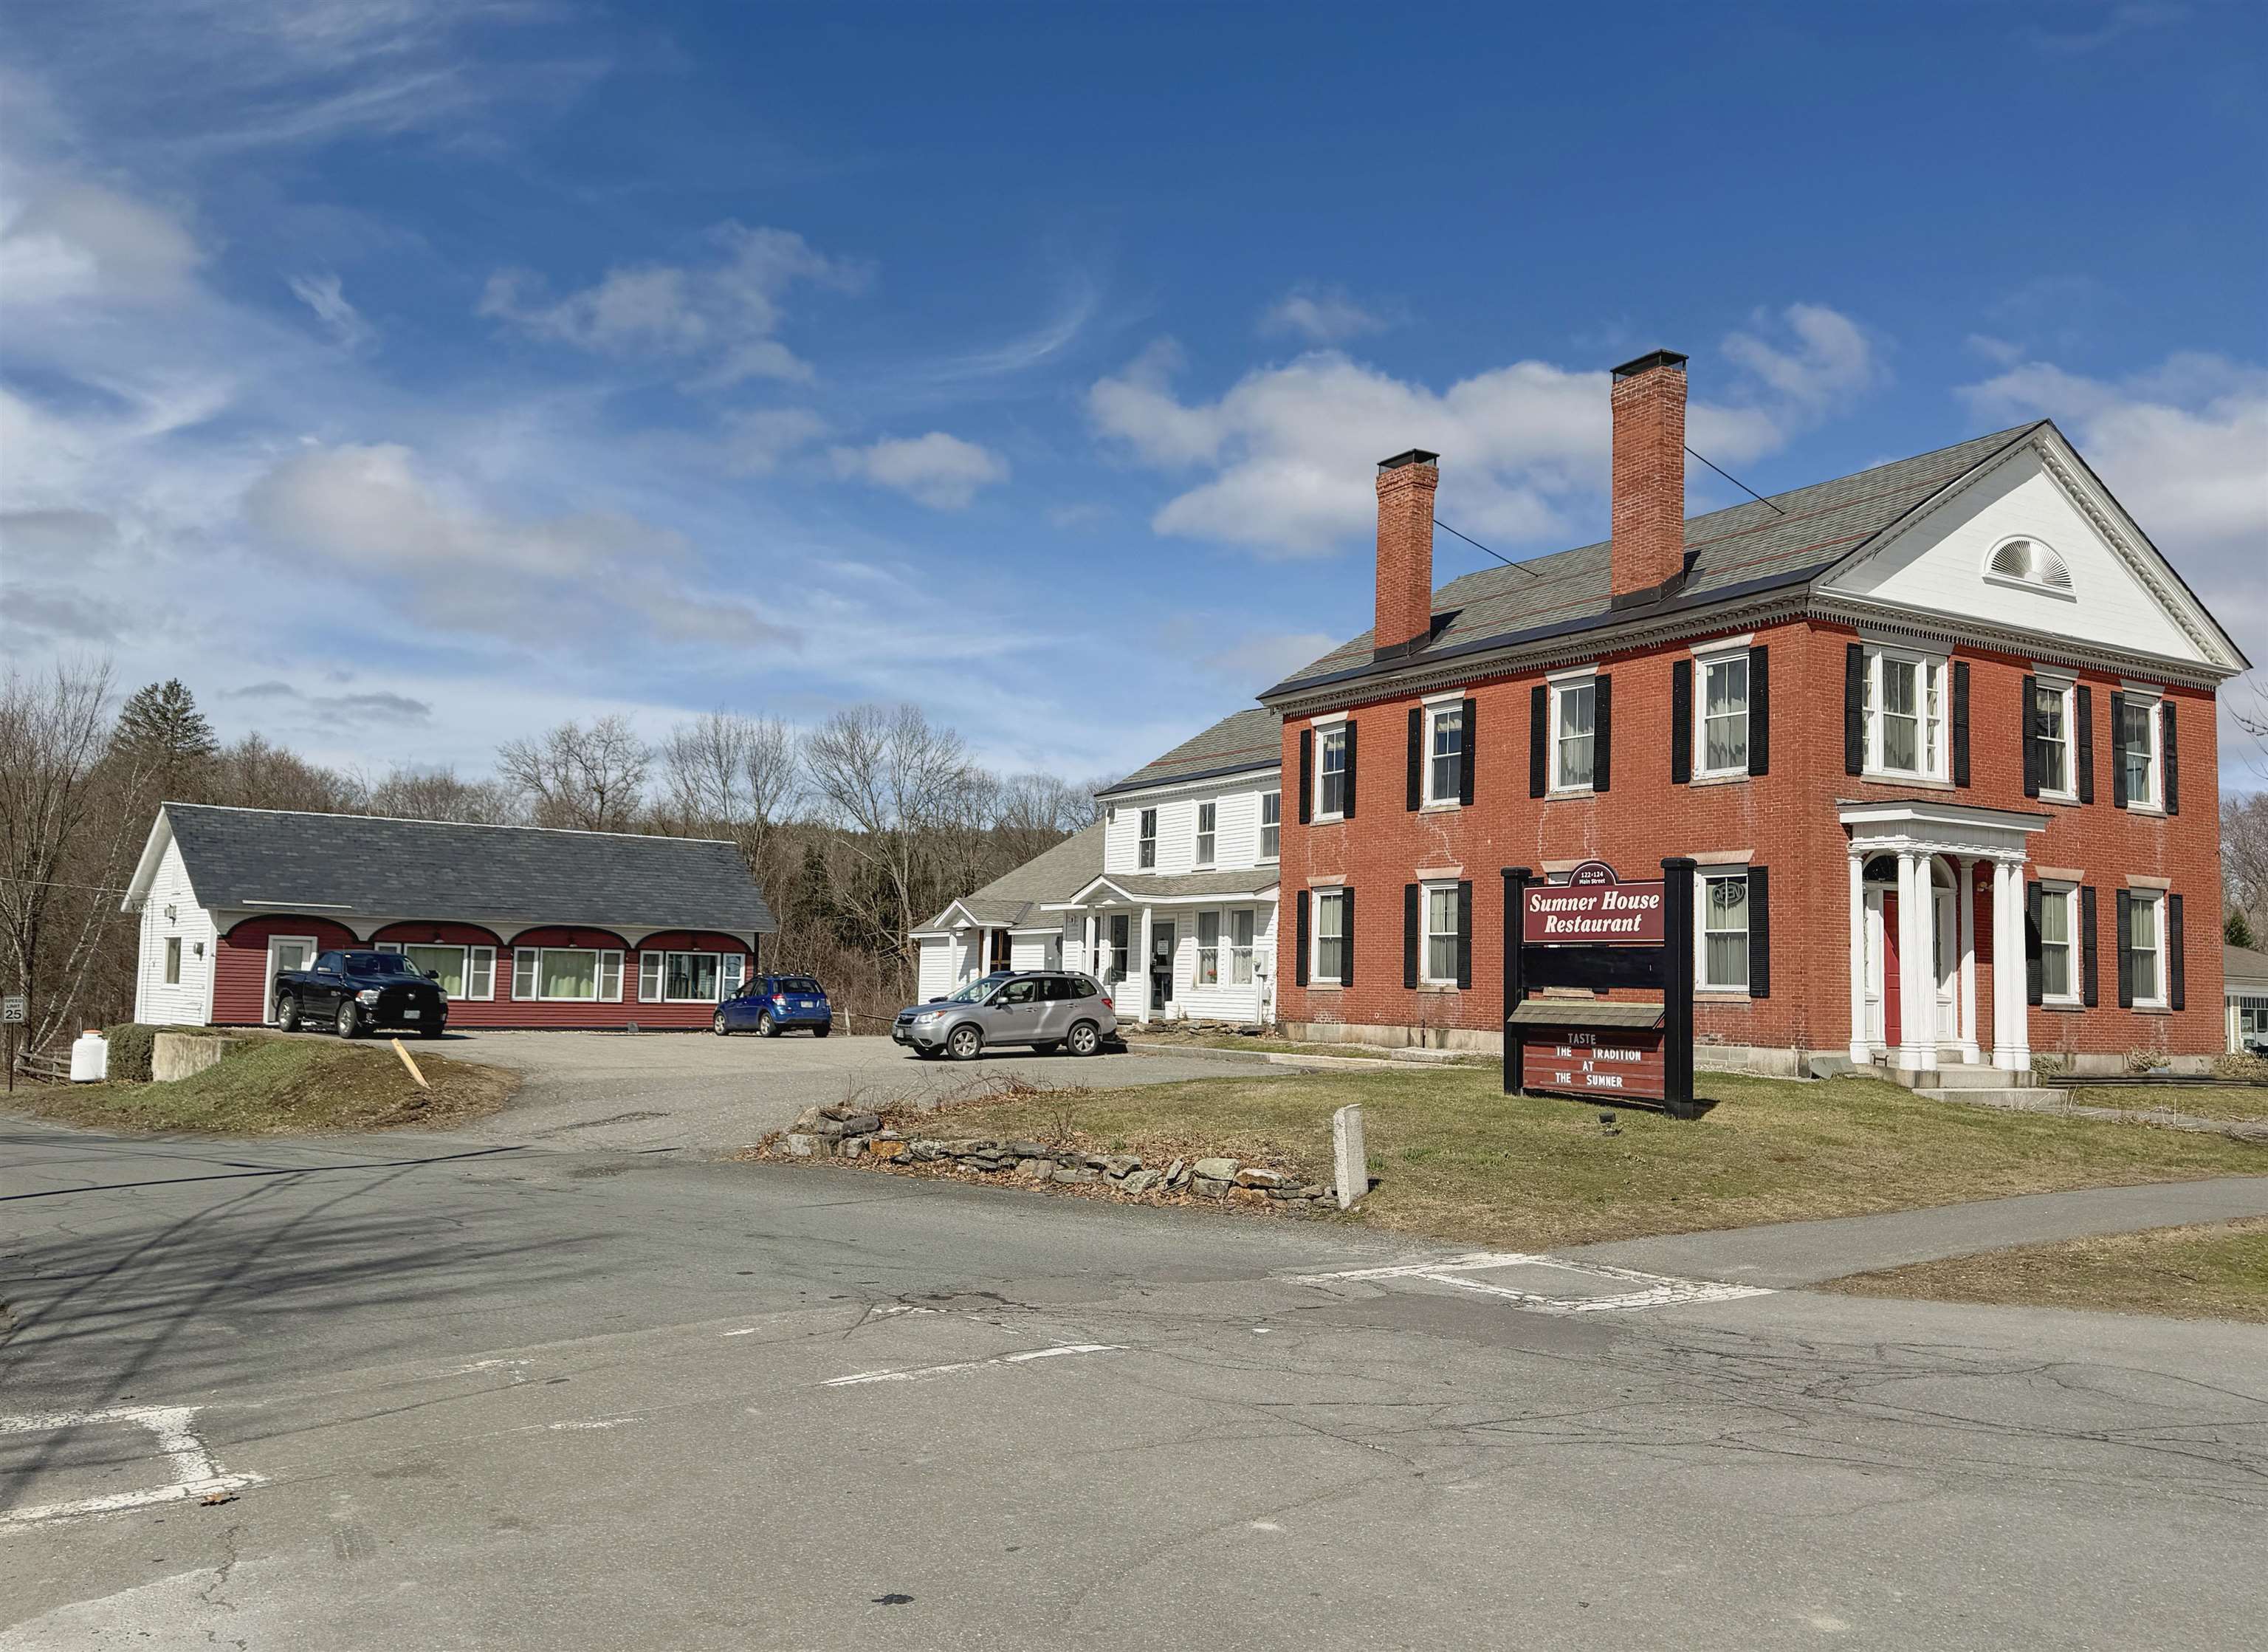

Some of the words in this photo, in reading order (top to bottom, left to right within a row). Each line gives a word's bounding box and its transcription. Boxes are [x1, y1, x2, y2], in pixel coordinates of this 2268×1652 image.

[1715, 885, 1742, 899] OPEN
[1530, 894, 1598, 913] Sumner
[1601, 891, 1660, 910] House
[1544, 914, 1642, 933] Restaurant
[5, 1010, 22, 1019] 25
[1567, 1033, 1596, 1044] TASTE
[1556, 1046, 1572, 1057] THE
[1592, 1048, 1641, 1060] TRADITION
[1582, 1060, 1594, 1072] AT
[1555, 1072, 1571, 1083] THE
[1586, 1075, 1623, 1087] SUMNER
